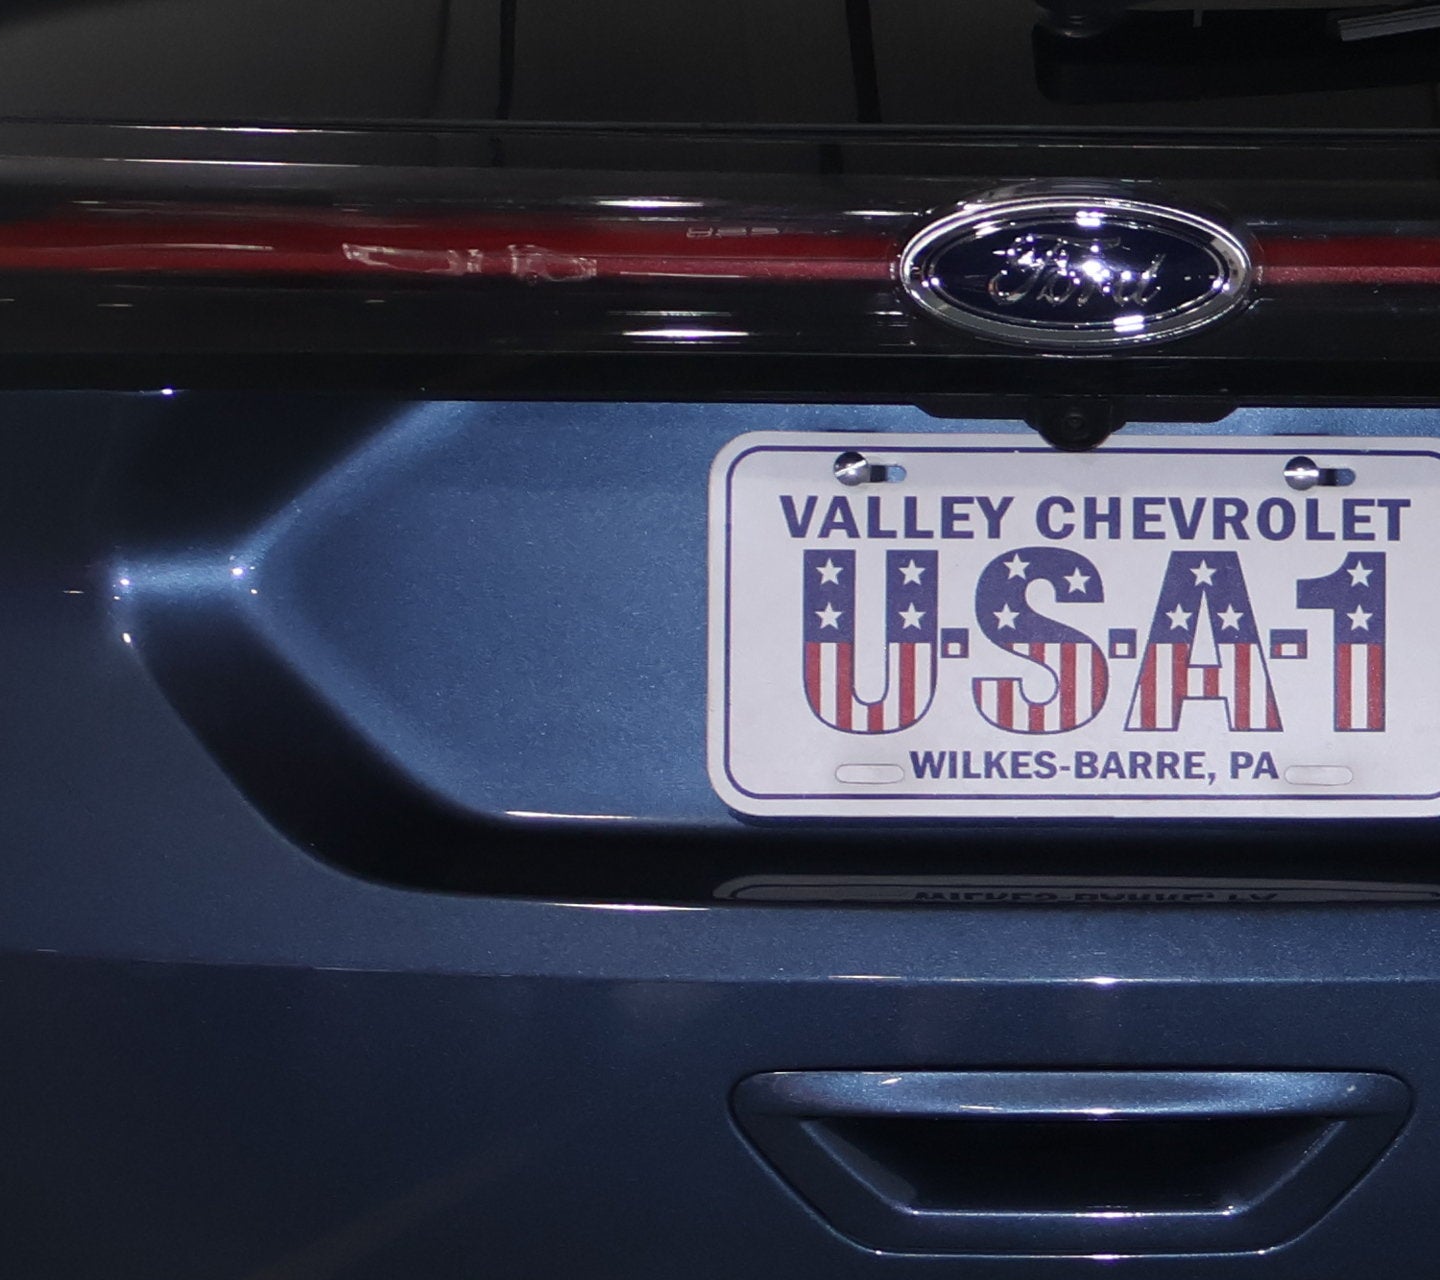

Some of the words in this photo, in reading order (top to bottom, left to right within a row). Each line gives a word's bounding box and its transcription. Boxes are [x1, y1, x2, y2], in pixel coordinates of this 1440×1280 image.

[779, 495, 1014, 540] VALLEY
[1035, 496, 1411, 542] CHEVROLET
[909, 750, 1217, 783] WILKES-BARRE,
[1229, 751, 1279, 780] PA
